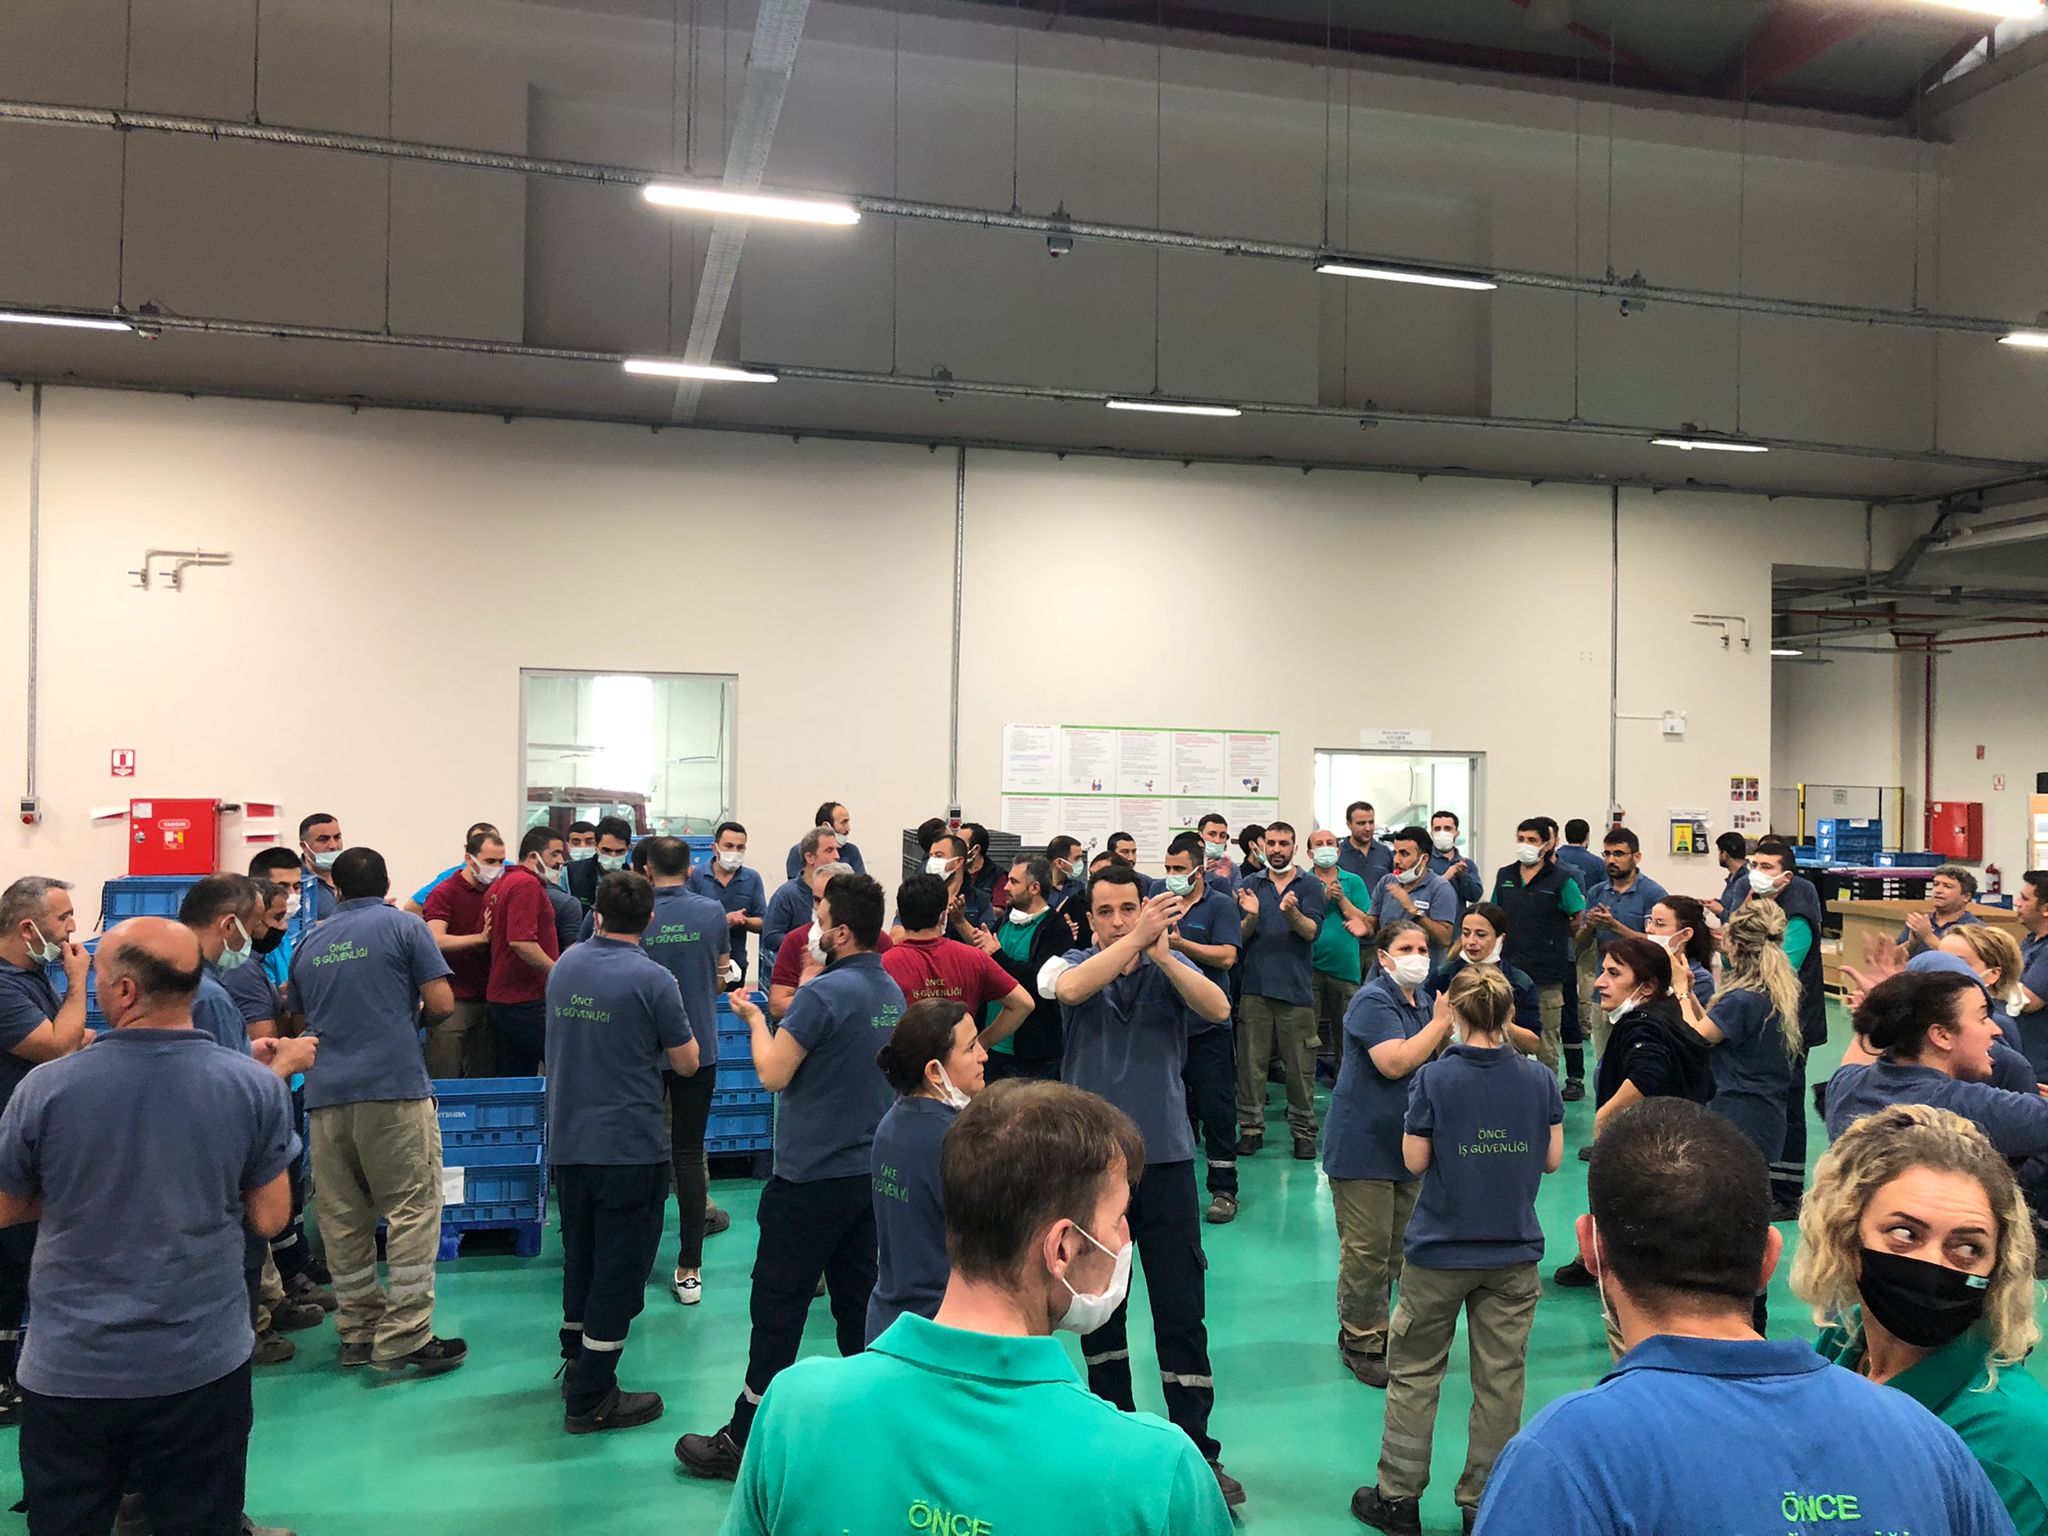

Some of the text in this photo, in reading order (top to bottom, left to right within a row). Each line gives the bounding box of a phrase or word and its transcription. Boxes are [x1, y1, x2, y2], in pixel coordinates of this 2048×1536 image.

[660, 923, 686, 933] ÖNCE
[329, 940, 353, 953] ÖNCE
[570, 993, 595, 1007] ÖNCE
[1478, 1127, 1508, 1140] ÖNCE
[1458, 1139, 1529, 1158] İŞ GÜVENLİĞİ
[1781, 1491, 1862, 1522] ÖNCE
[908, 1499, 993, 1536] ÖNCE
